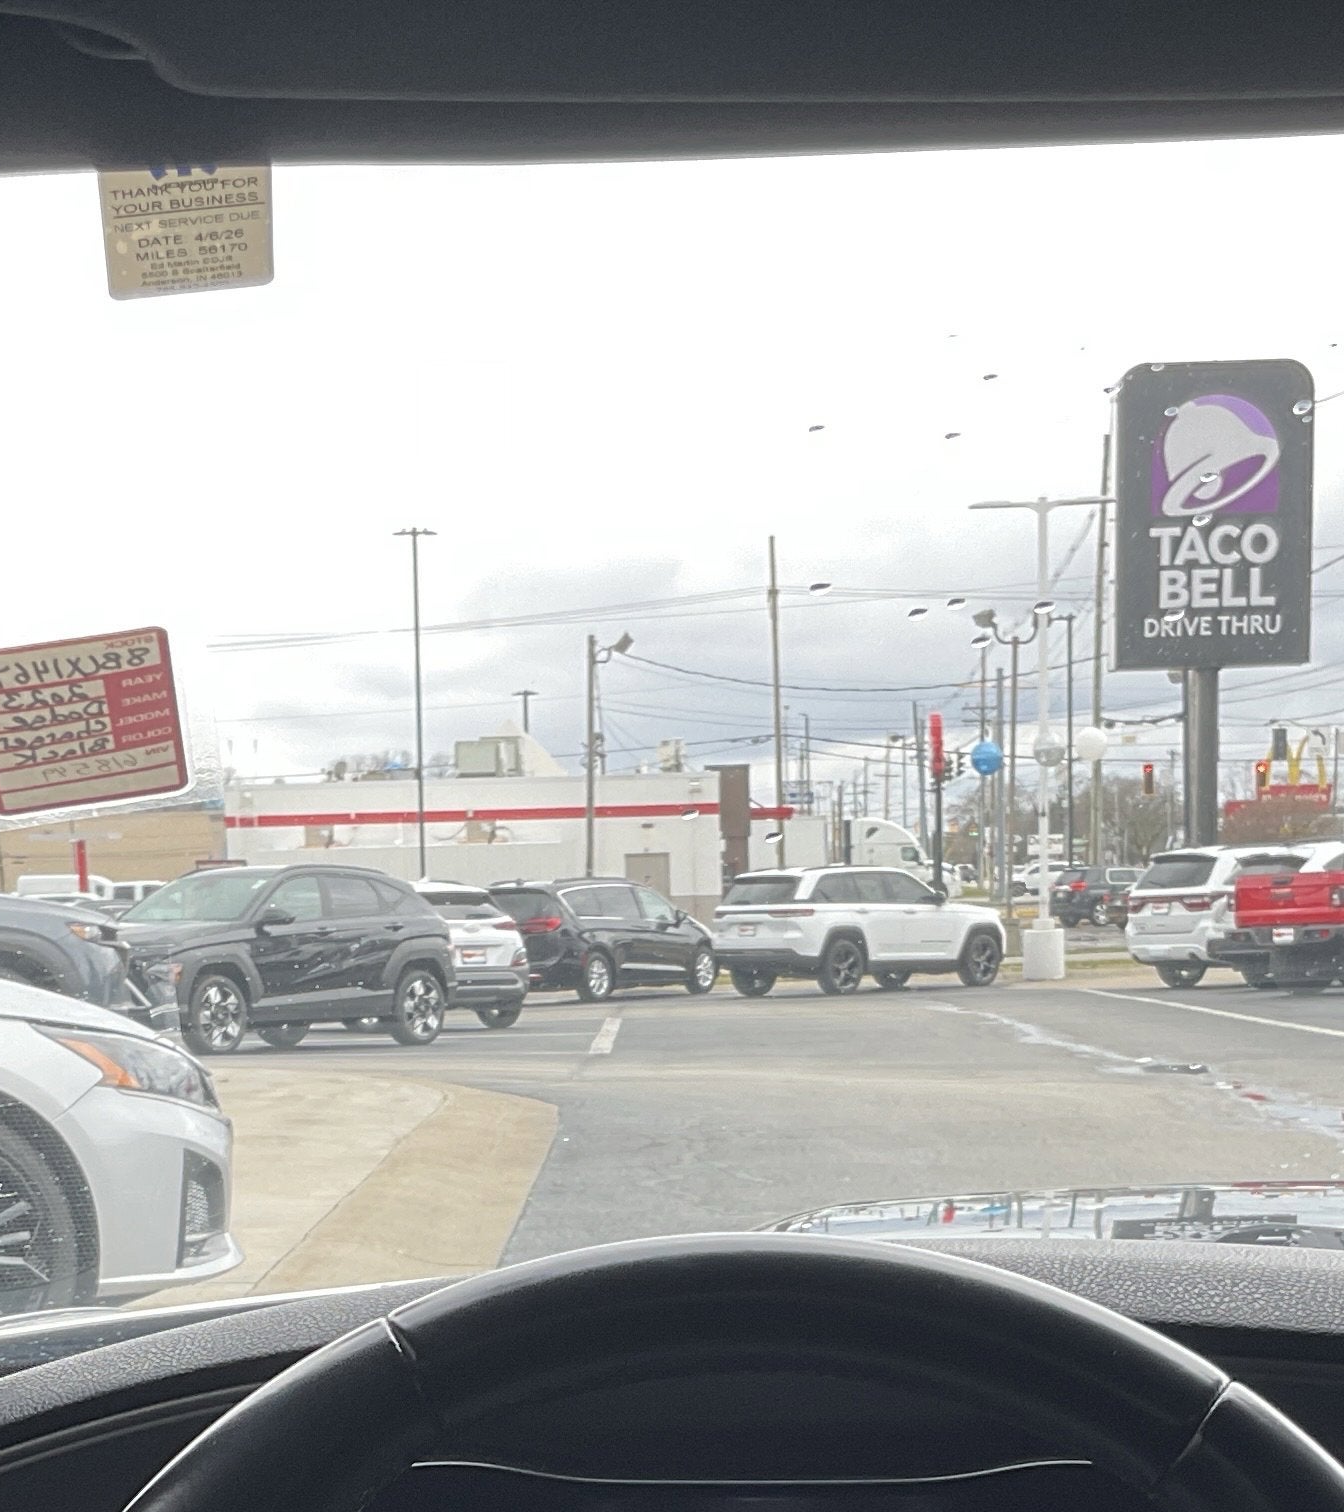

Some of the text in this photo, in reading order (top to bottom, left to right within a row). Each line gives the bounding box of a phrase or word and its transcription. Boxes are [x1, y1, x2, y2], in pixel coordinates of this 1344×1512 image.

[110, 183, 171, 201] THANK
[177, 180, 216, 194] YOU
[219, 176, 258, 190] FOR
[111, 192, 259, 215] YOUR BUSINESS
[113, 210, 261, 233] NEXT SERVICE DUE
[138, 234, 183, 248] DATE
[135, 248, 188, 262] MILES
[1149, 523, 1280, 567] TACO
[1158, 567, 1276, 610] BELL
[1143, 614, 1282, 638] DRIVE THRU
